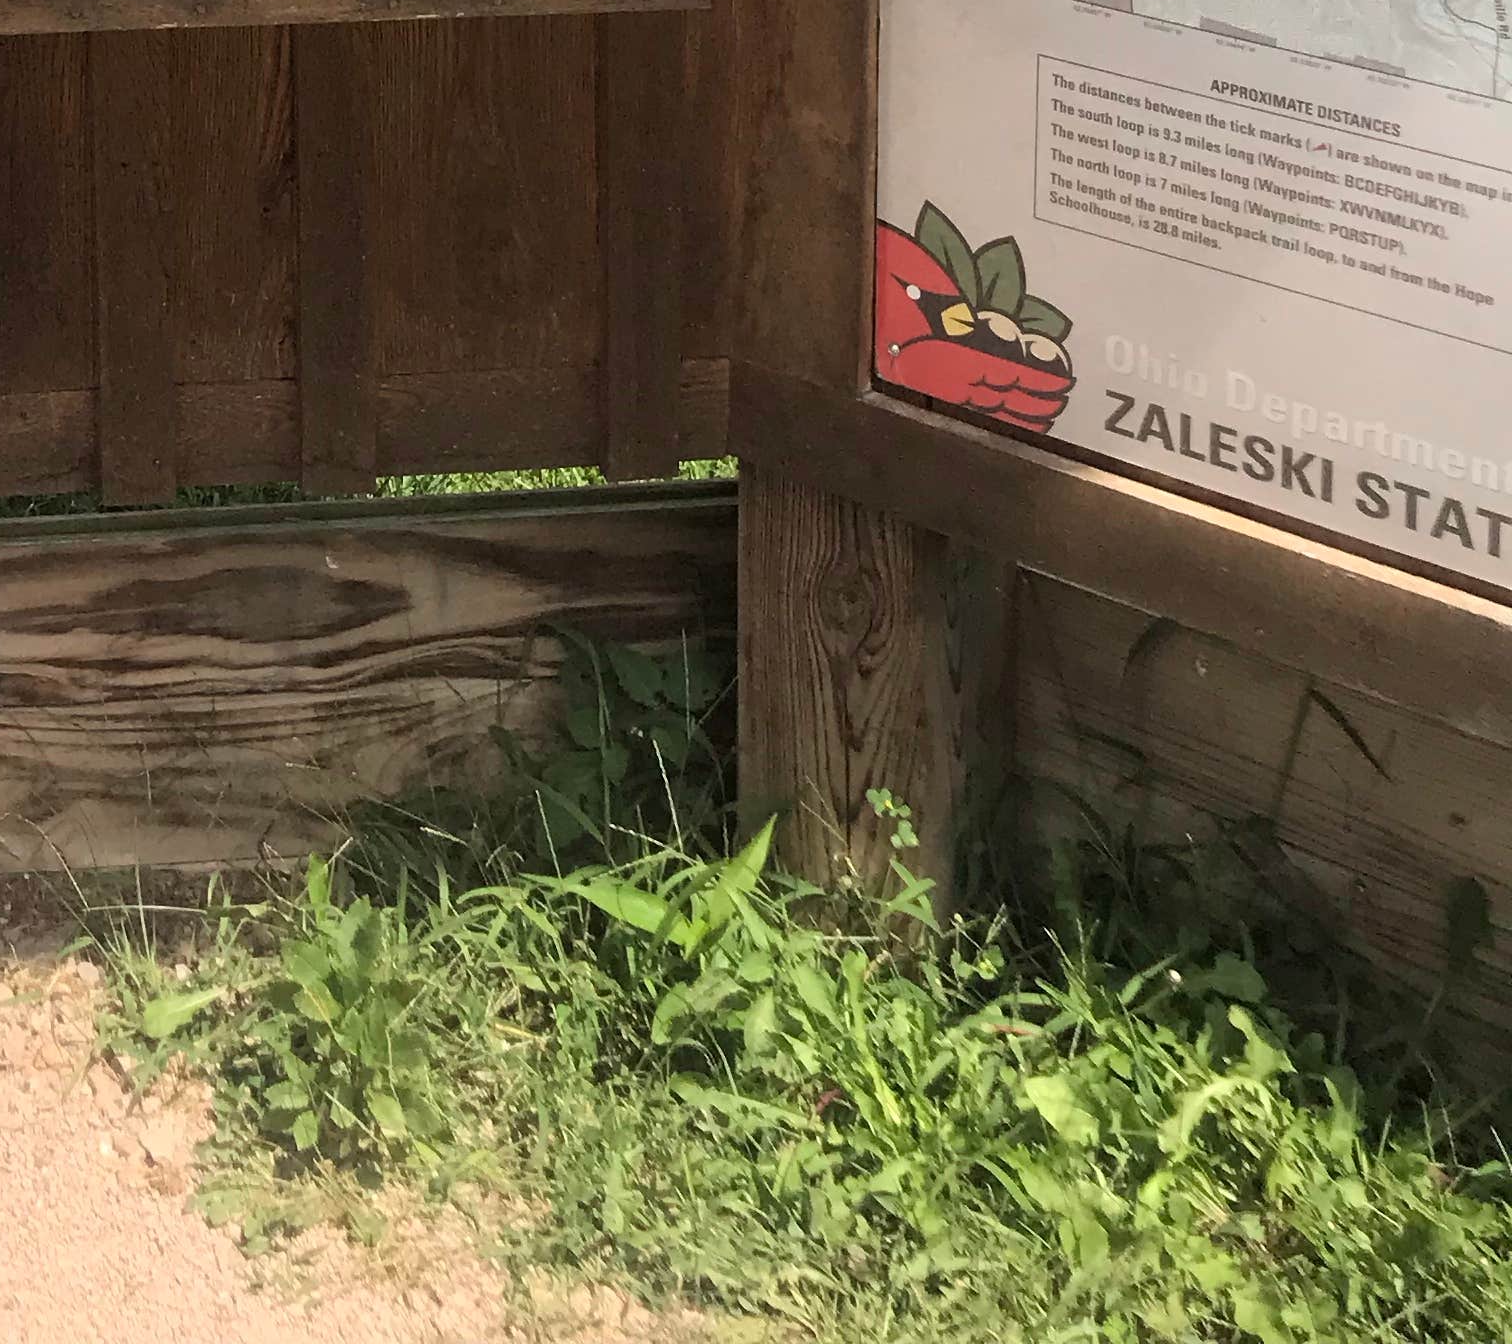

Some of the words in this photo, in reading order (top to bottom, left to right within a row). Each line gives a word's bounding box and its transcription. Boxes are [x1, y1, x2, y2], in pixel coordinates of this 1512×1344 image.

[1210, 79, 1314, 116] APPROXIMATE
[1317, 105, 1402, 138] DISTANCES
[1104, 389, 1334, 504] ZALESKI
